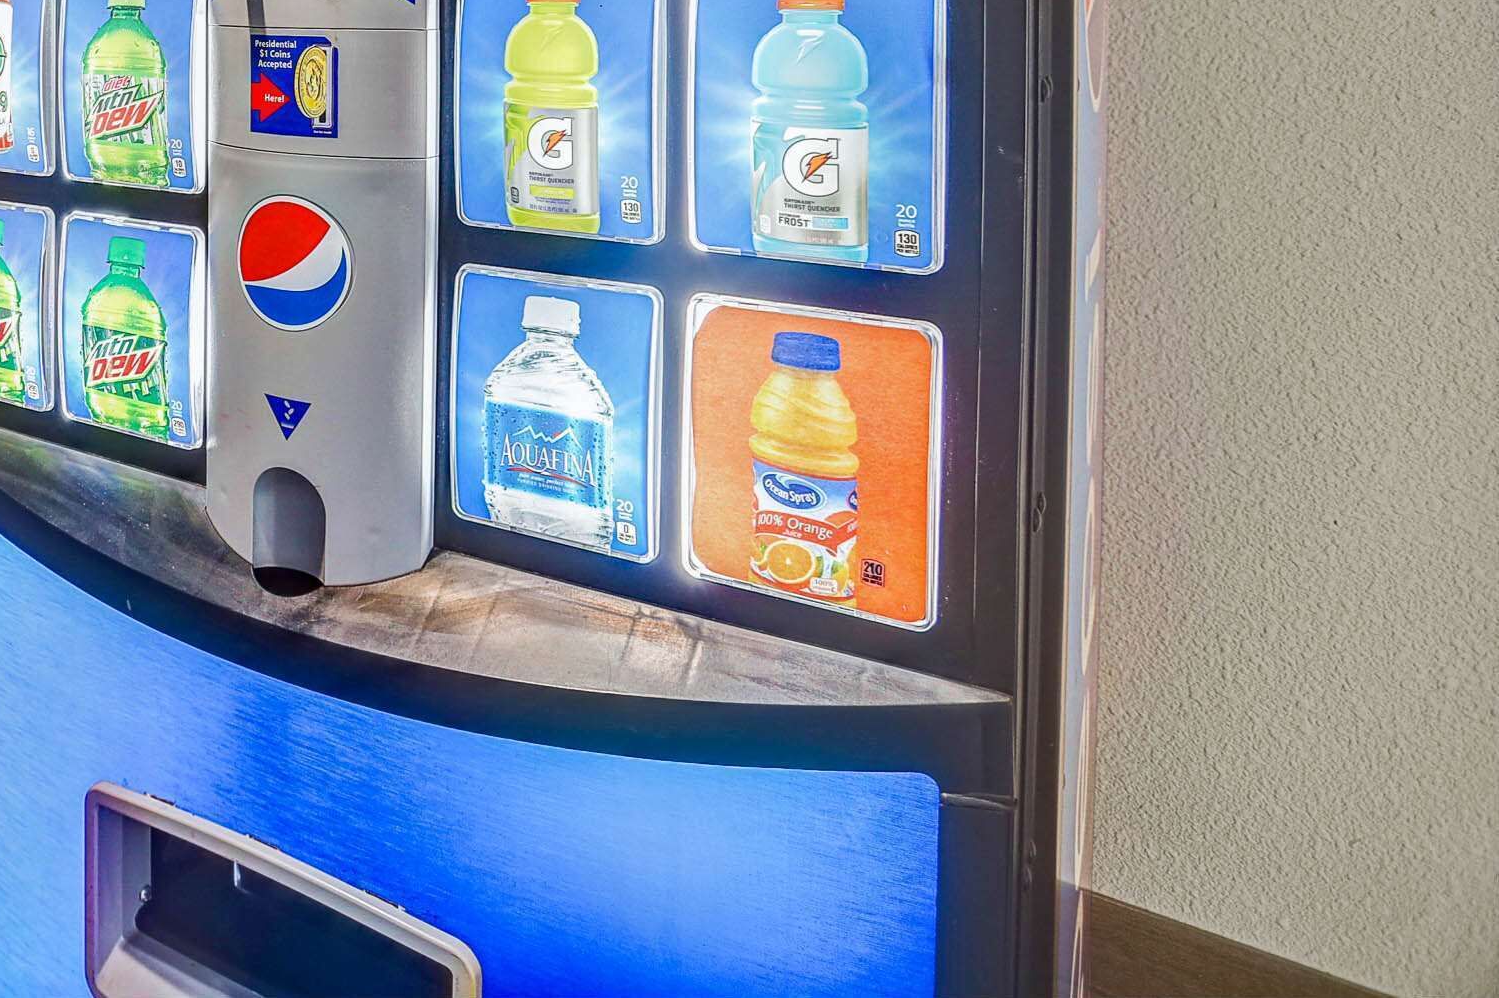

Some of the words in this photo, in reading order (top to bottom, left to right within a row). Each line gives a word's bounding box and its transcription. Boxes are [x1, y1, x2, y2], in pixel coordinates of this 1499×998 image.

[255, 40, 297, 49] Presidential
[259, 49, 268, 58] $1
[270, 50, 291, 59] Coins
[258, 60, 293, 70] Accepted
[103, 76, 131, 91] diet
[264, 94, 285, 103] Here!
[171, 139, 182, 149] 20
[527, 117, 574, 170] G
[782, 138, 839, 197] G
[621, 176, 638, 189] 20
[623, 202, 639, 212] 130
[784, 202, 805, 210] THIRST
[895, 204, 917, 218] 20
[778, 216, 809, 227] FROST
[898, 233, 917, 244] 130
[501, 433, 597, 487] AQUAFINA
[765, 479, 790, 500] Ocean
[789, 488, 817, 505] Spray
[616, 499, 634, 512] 20
[758, 512, 783, 527] 100%
[787, 518, 833, 540] Orange
